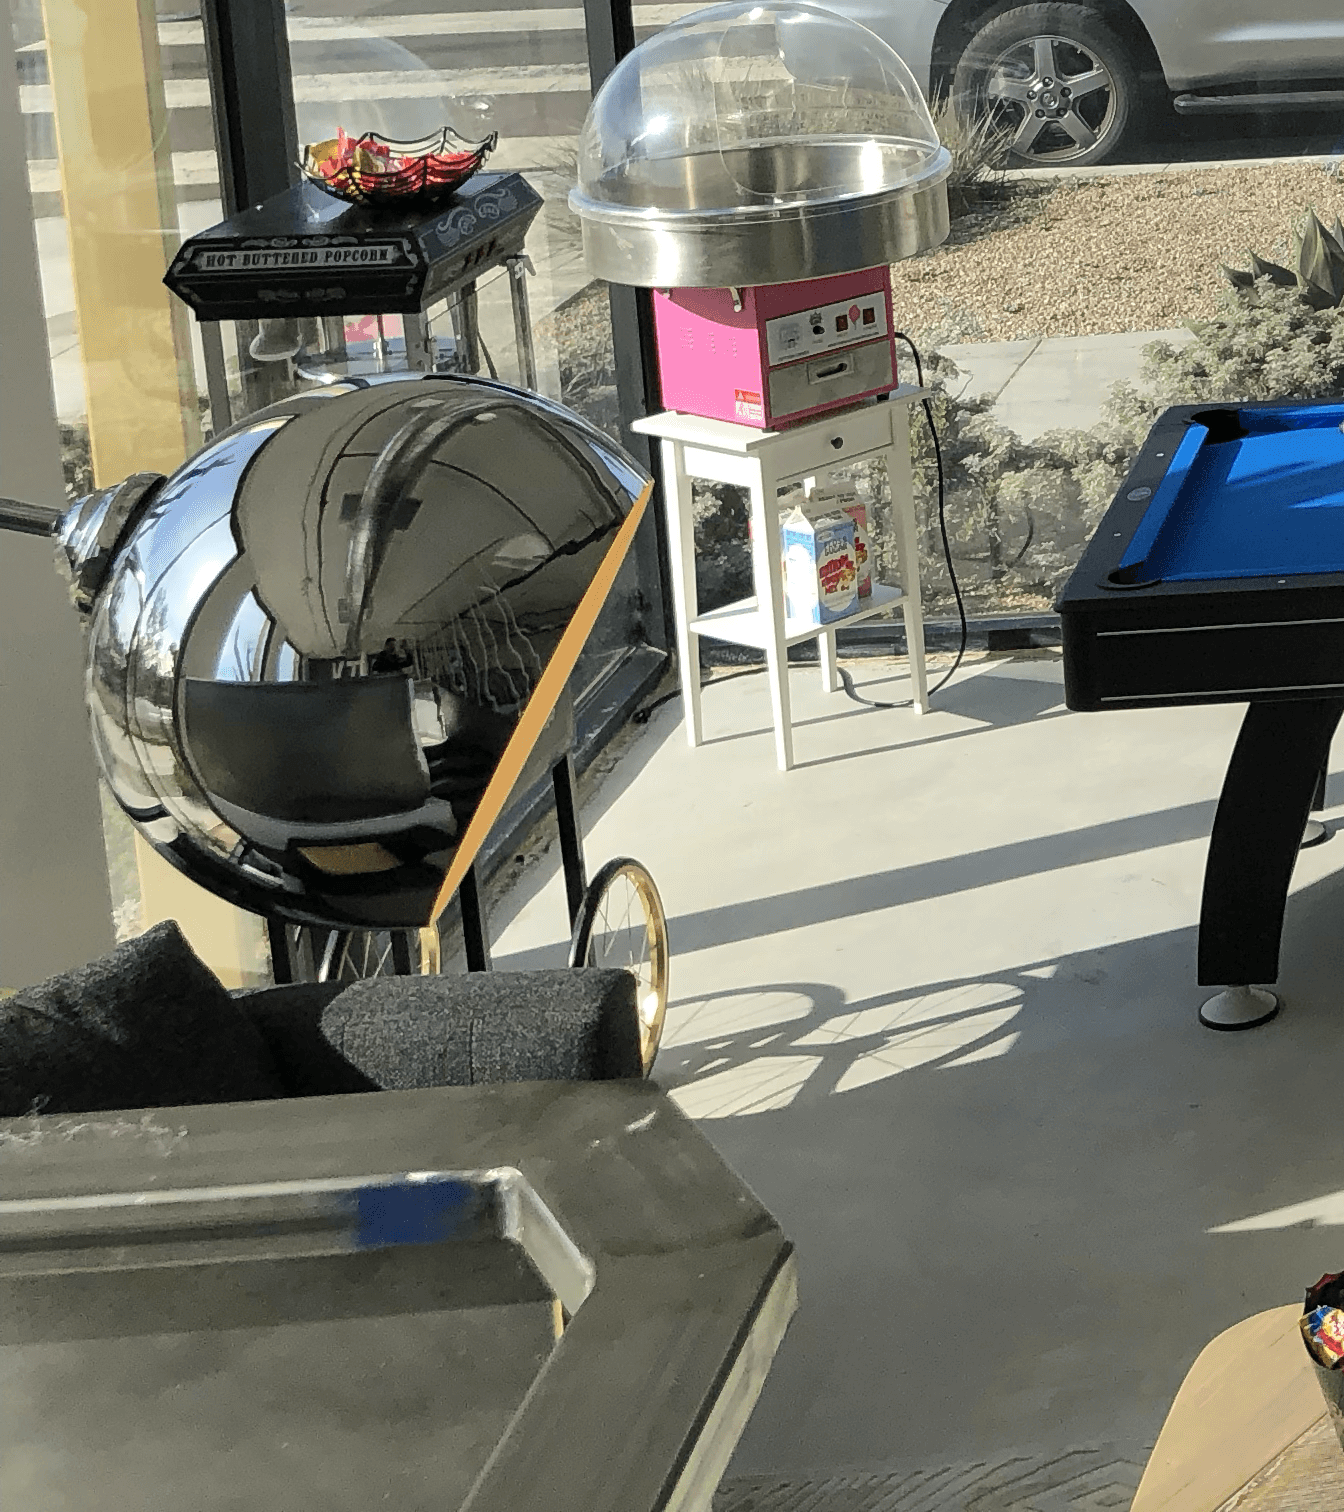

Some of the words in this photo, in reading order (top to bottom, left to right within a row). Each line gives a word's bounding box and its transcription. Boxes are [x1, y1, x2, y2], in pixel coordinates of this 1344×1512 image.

[206, 253, 237, 268] HOT
[242, 251, 319, 267] BUTTERED
[324, 247, 389, 264] POPCORN
